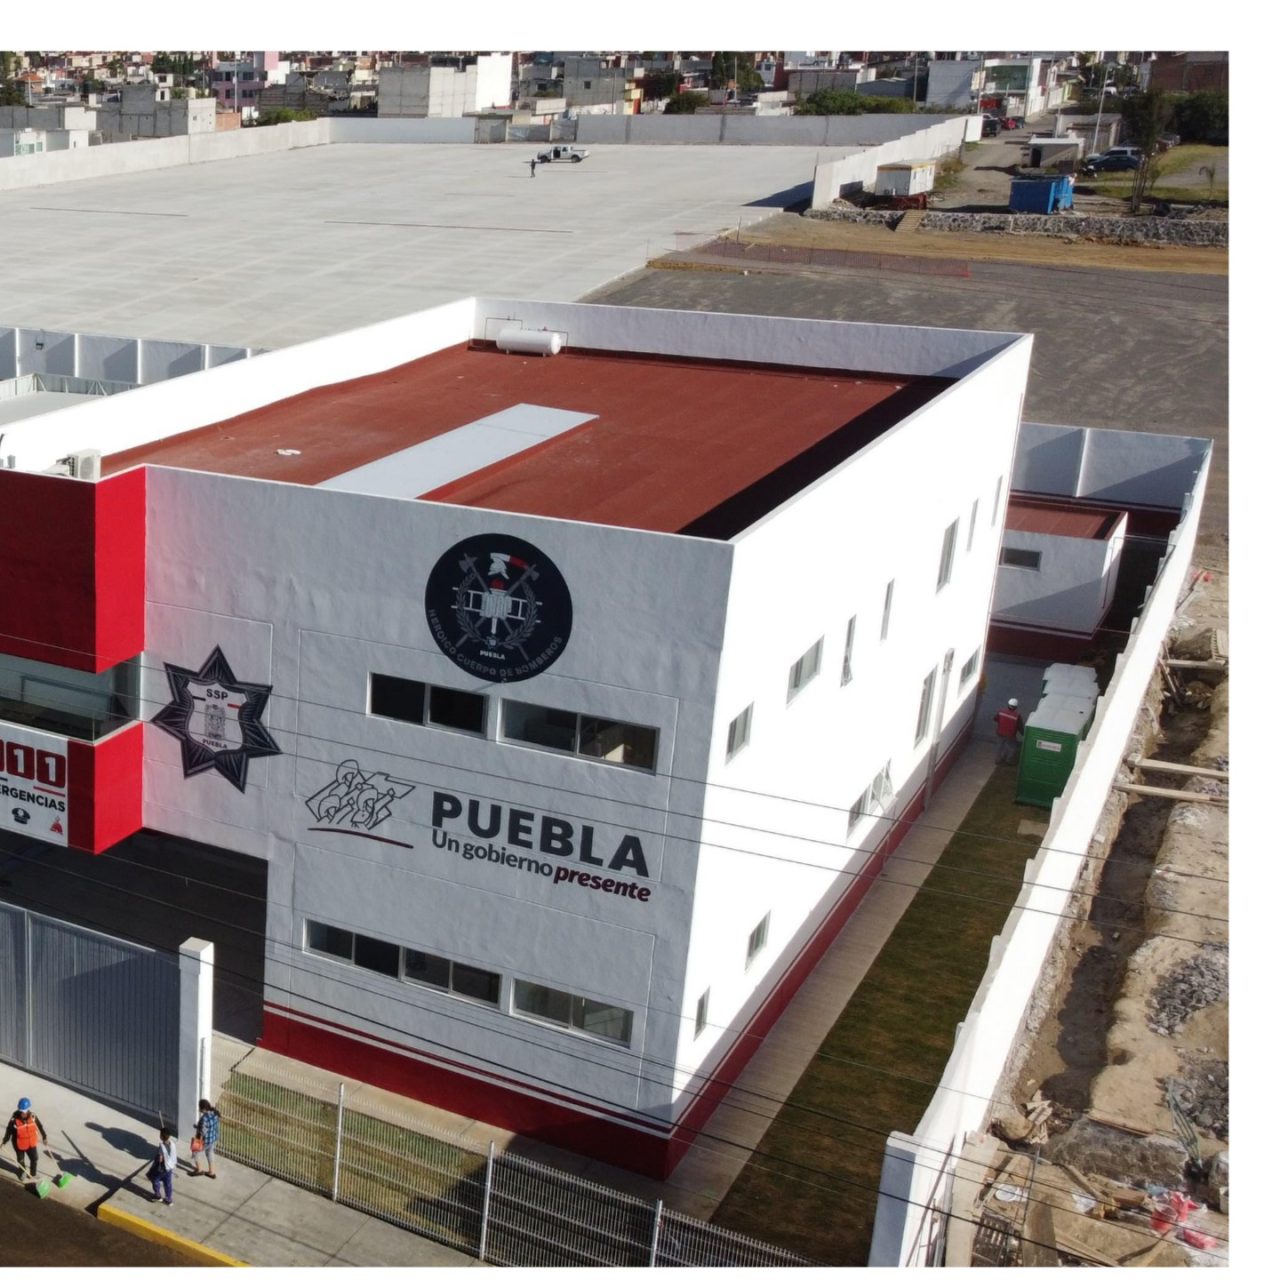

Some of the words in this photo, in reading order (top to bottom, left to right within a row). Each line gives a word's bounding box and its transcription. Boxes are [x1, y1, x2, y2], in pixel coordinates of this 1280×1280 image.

[427, 609, 457, 654] HEROICO
[457, 653, 497, 676] CUERPO
[515, 636, 563, 676] BOMBEROS
[206, 688, 228, 700] SSP
[202, 738, 228, 749] PUEBLA
[432, 791, 650, 878] PUEBLA
[432, 828, 460, 853] Un
[462, 842, 554, 877] gobierno
[553, 865, 651, 902] presente
